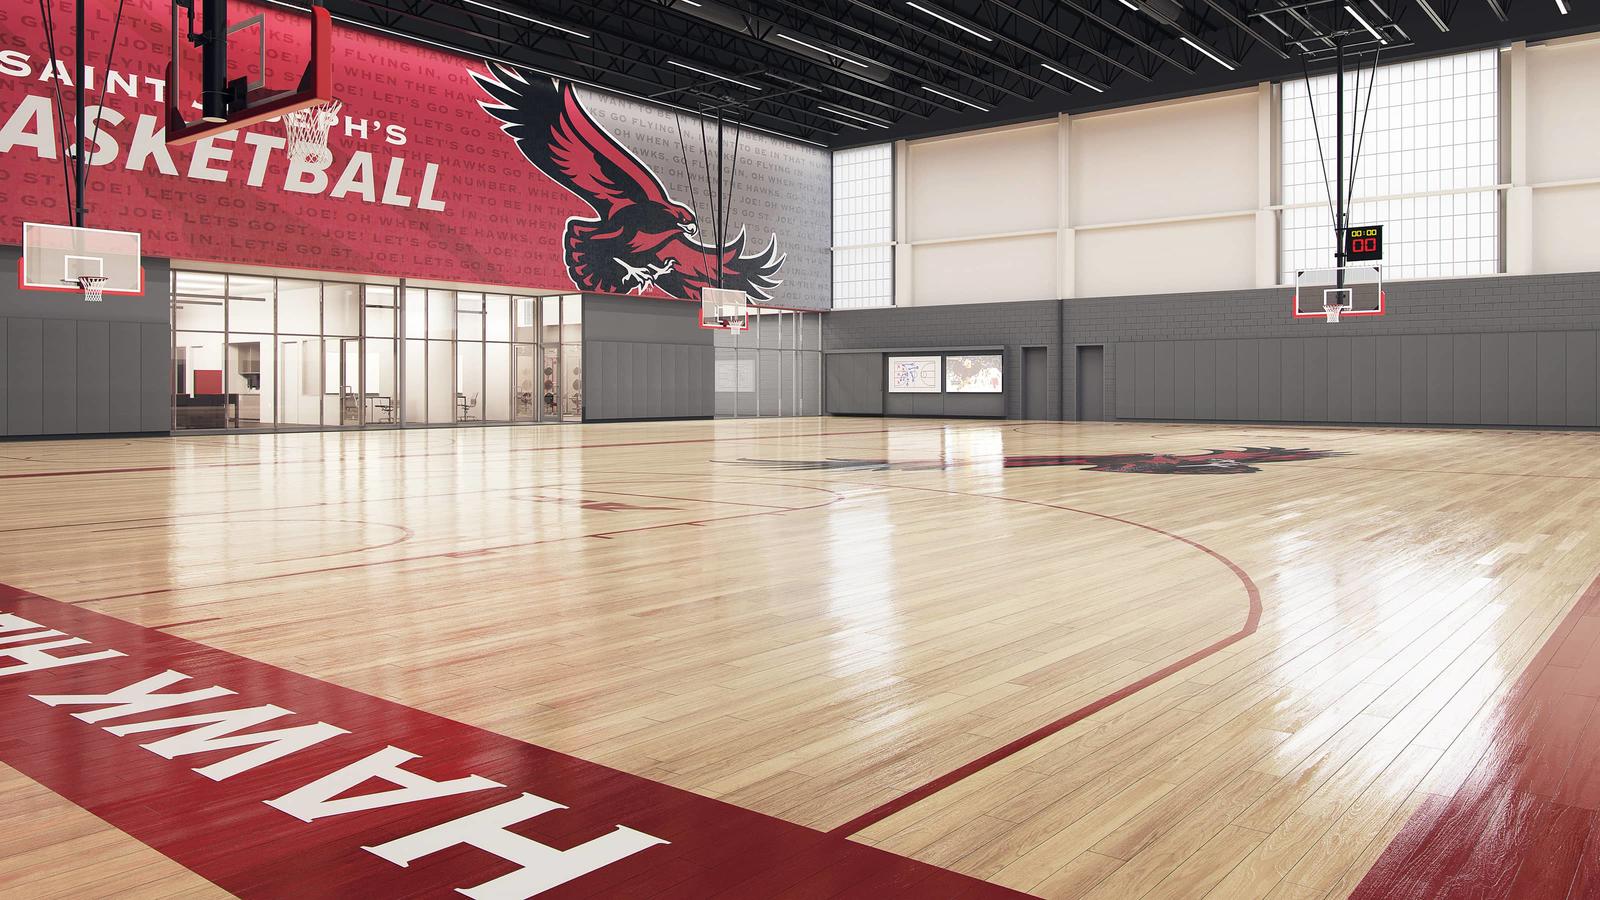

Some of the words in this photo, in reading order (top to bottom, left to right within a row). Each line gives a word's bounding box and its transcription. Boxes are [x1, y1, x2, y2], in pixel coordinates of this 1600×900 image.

[0, 50, 166, 103] SAINT
[117, 35, 172, 57] JOE!
[333, 81, 363, 97] OE!
[372, 90, 419, 109] LET'S
[425, 101, 448, 115] GO
[454, 107, 478, 121] ST.
[343, 47, 410, 72] FLYING
[446, 72, 468, 86] OH
[343, 65, 397, 86] WHEN
[403, 79, 437, 95] THE
[86, 50, 162, 75] FLYIN
[365, 106, 406, 123] JOE!
[412, 116, 454, 133] LETS
[460, 125, 481, 138] GO
[609, 111, 627, 123] GO
[631, 117, 674, 134] FLYING
[414, 133, 459, 150] LET'S
[464, 143, 486, 155] GO
[613, 127, 630, 138] OH
[634, 132, 669, 147] WHEN
[738, 156, 753, 166] GO
[756, 160, 790, 174] FLYING
[440, 155, 497, 173] HAWKS
[502, 166, 522, 178] GO
[668, 167, 683, 178] OH
[751, 171, 764, 181] OH
[403, 166, 446, 182] THT
[527, 186, 568, 201] WHEN
[669, 182, 699, 194] LETS
[738, 195, 761, 206] JOE!
[764, 200, 776, 208] OH
[90, 180, 131, 196] OE!
[144, 187, 207, 205] LET'S
[217, 196, 246, 209] GO
[255, 200, 286, 214] ST.
[294, 205, 337, 220] JOE!
[345, 211, 371, 224] OH
[379, 216, 429, 230] WHEN
[436, 223, 468, 235] THE
[538, 235, 556, 245] GO
[476, 194, 497, 206] TO
[503, 199, 521, 209] BE
[527, 202, 542, 212] IN
[741, 208, 755, 217] GO
[20, 194, 57, 209] GO
[117, 205, 173, 221] JOE!
[183, 212, 239, 228] LETS
[247, 219, 277, 232] GO
[284, 223, 316, 236] ST.
[321, 227, 364, 241] JOE!
[372, 233, 419, 247] LET'S
[426, 238, 448, 250] GO
[488, 213, 509, 224] OH
[515, 216, 556, 230] WHEN
[1351, 229, 1377, 238] 00:00
[189, 233, 220, 246] IN.
[230, 237, 288, 252] LET'S
[295, 243, 322, 255] GO
[365, 250, 406, 263] JOE!
[412, 254, 454, 267] LETS
[459, 259, 481, 269] GO
[750, 236, 763, 244] GO
[1352, 238, 1377, 253] 00
[28, 668, 672, 900] HAWK
